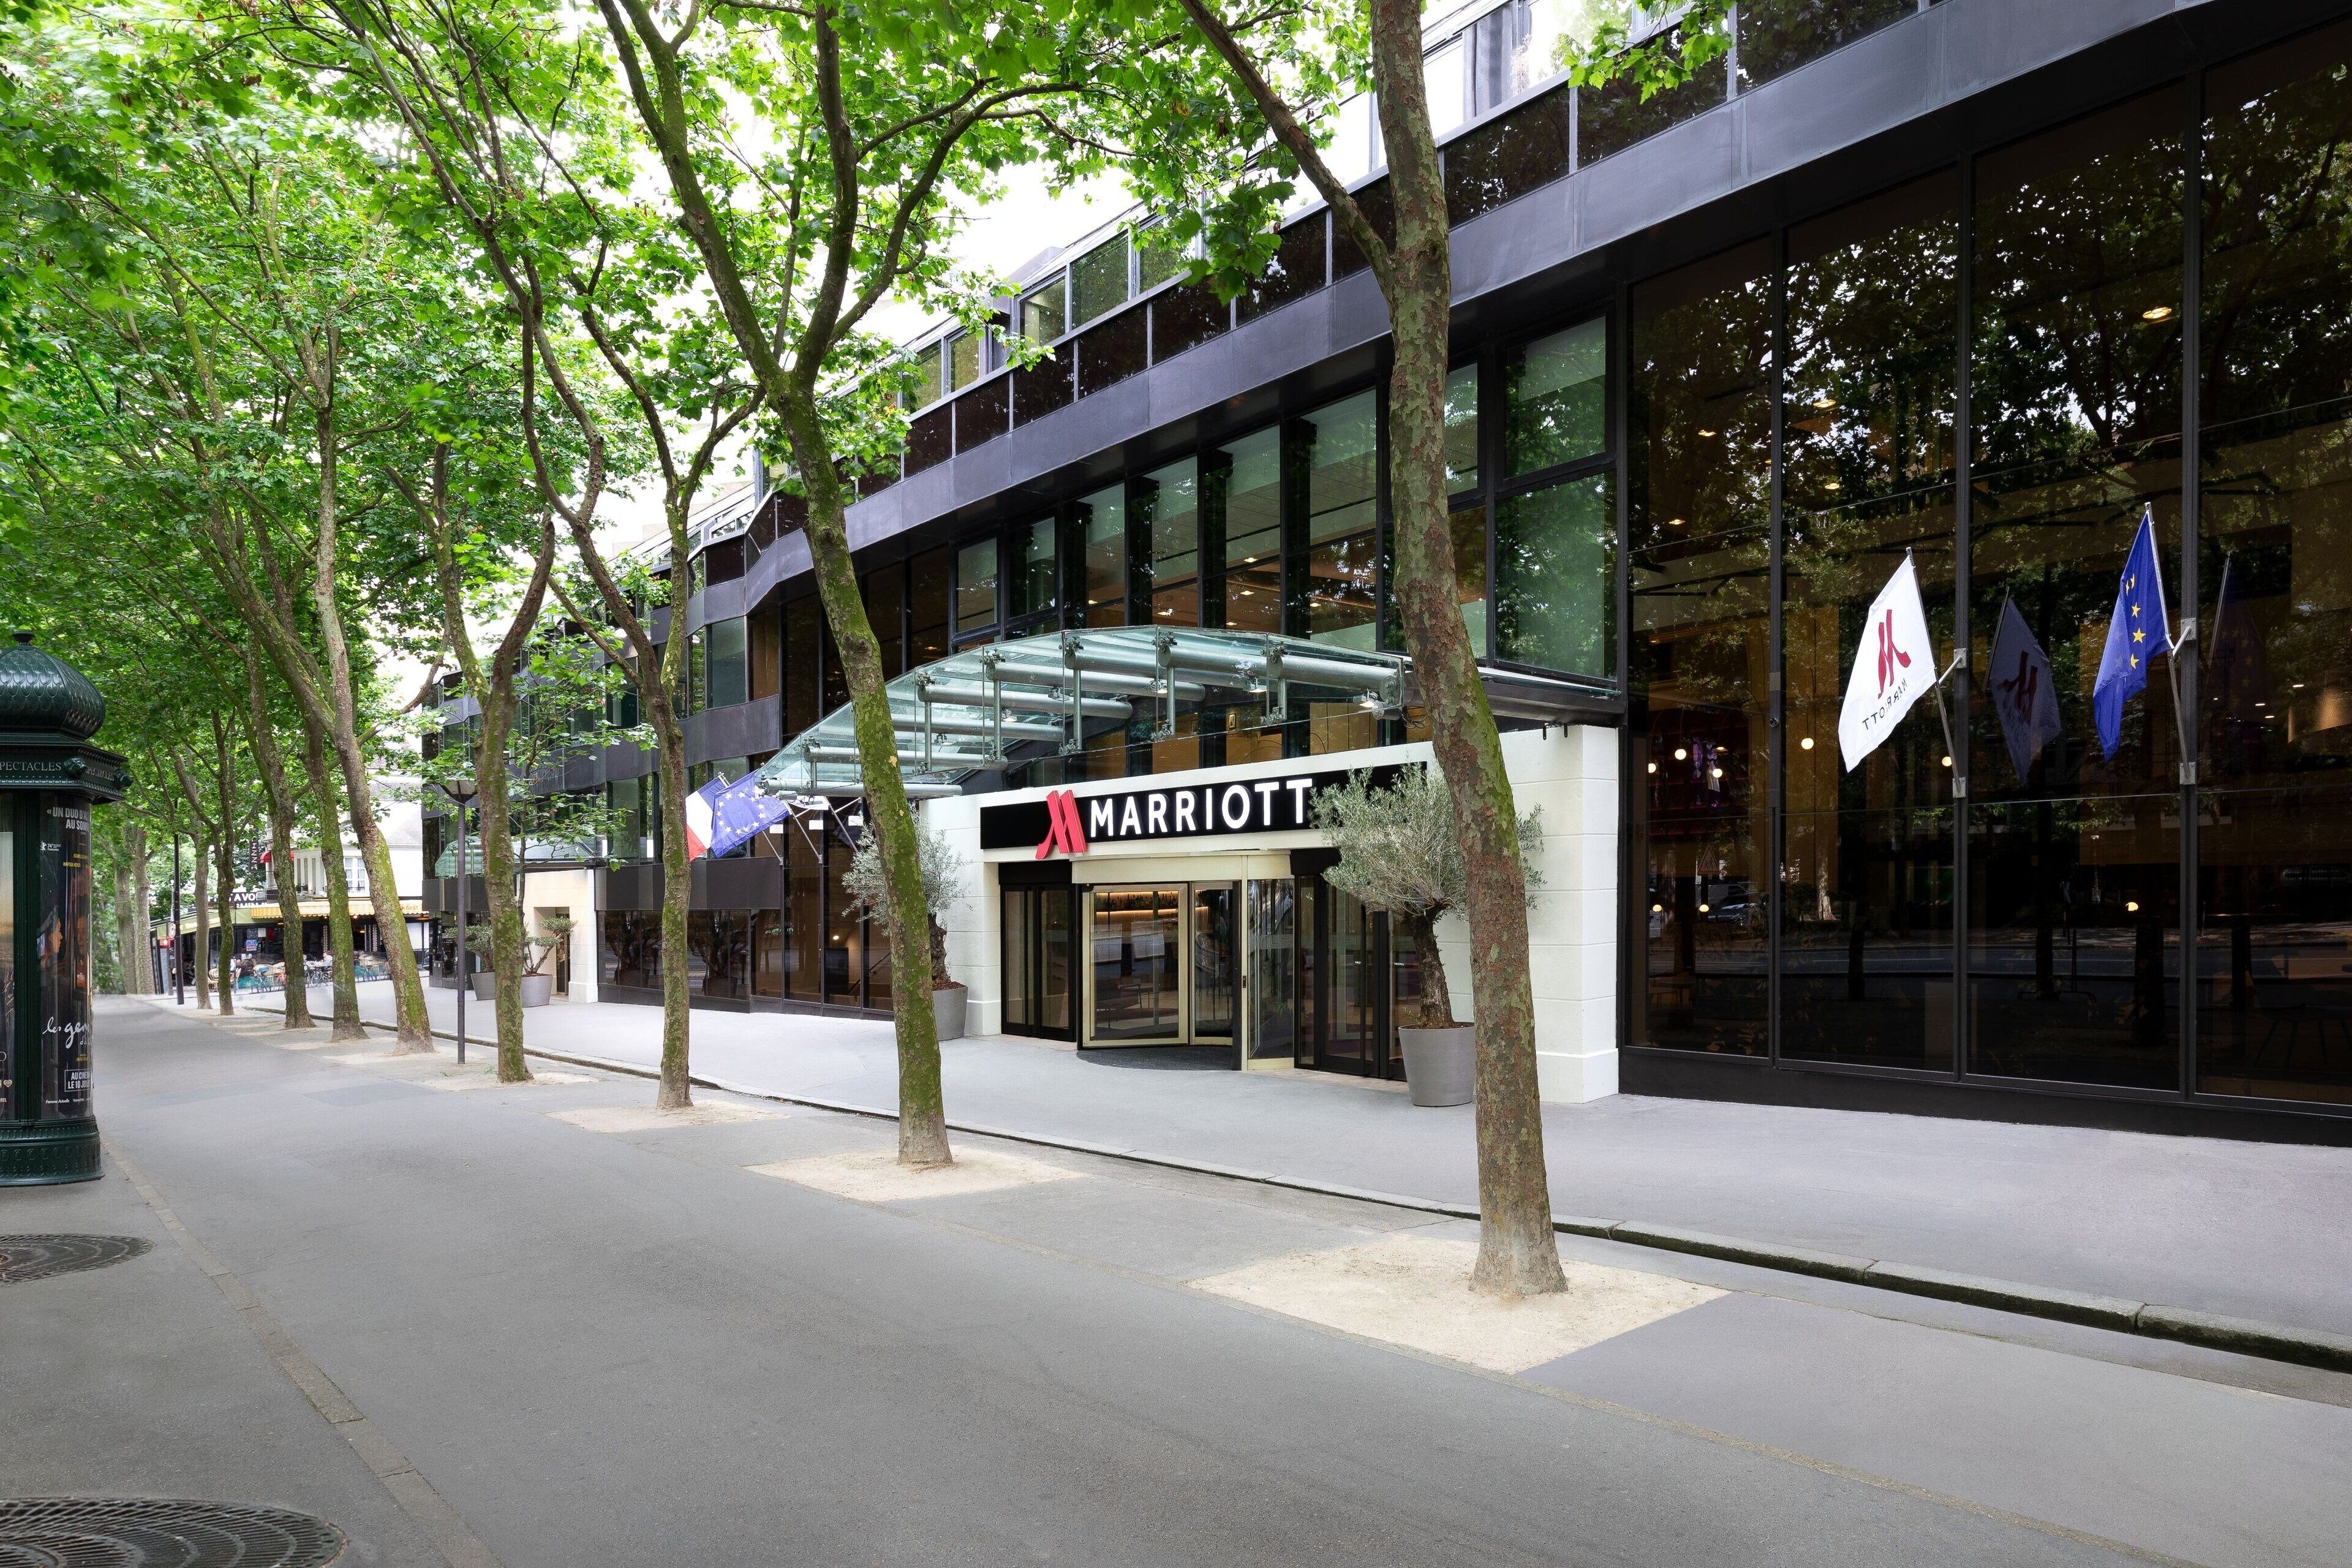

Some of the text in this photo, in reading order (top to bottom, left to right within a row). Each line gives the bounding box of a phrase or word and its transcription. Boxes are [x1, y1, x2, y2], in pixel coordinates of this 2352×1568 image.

[0, 761, 61, 771] PECTACLES
[53, 807, 63, 817] UN
[66, 808, 78, 819] DUO
[1090, 777, 1313, 838] MARRIOTT
[66, 819, 75, 829] AU
[42, 1016, 61, 1035] les
[68, 1080, 74, 1089] LE
